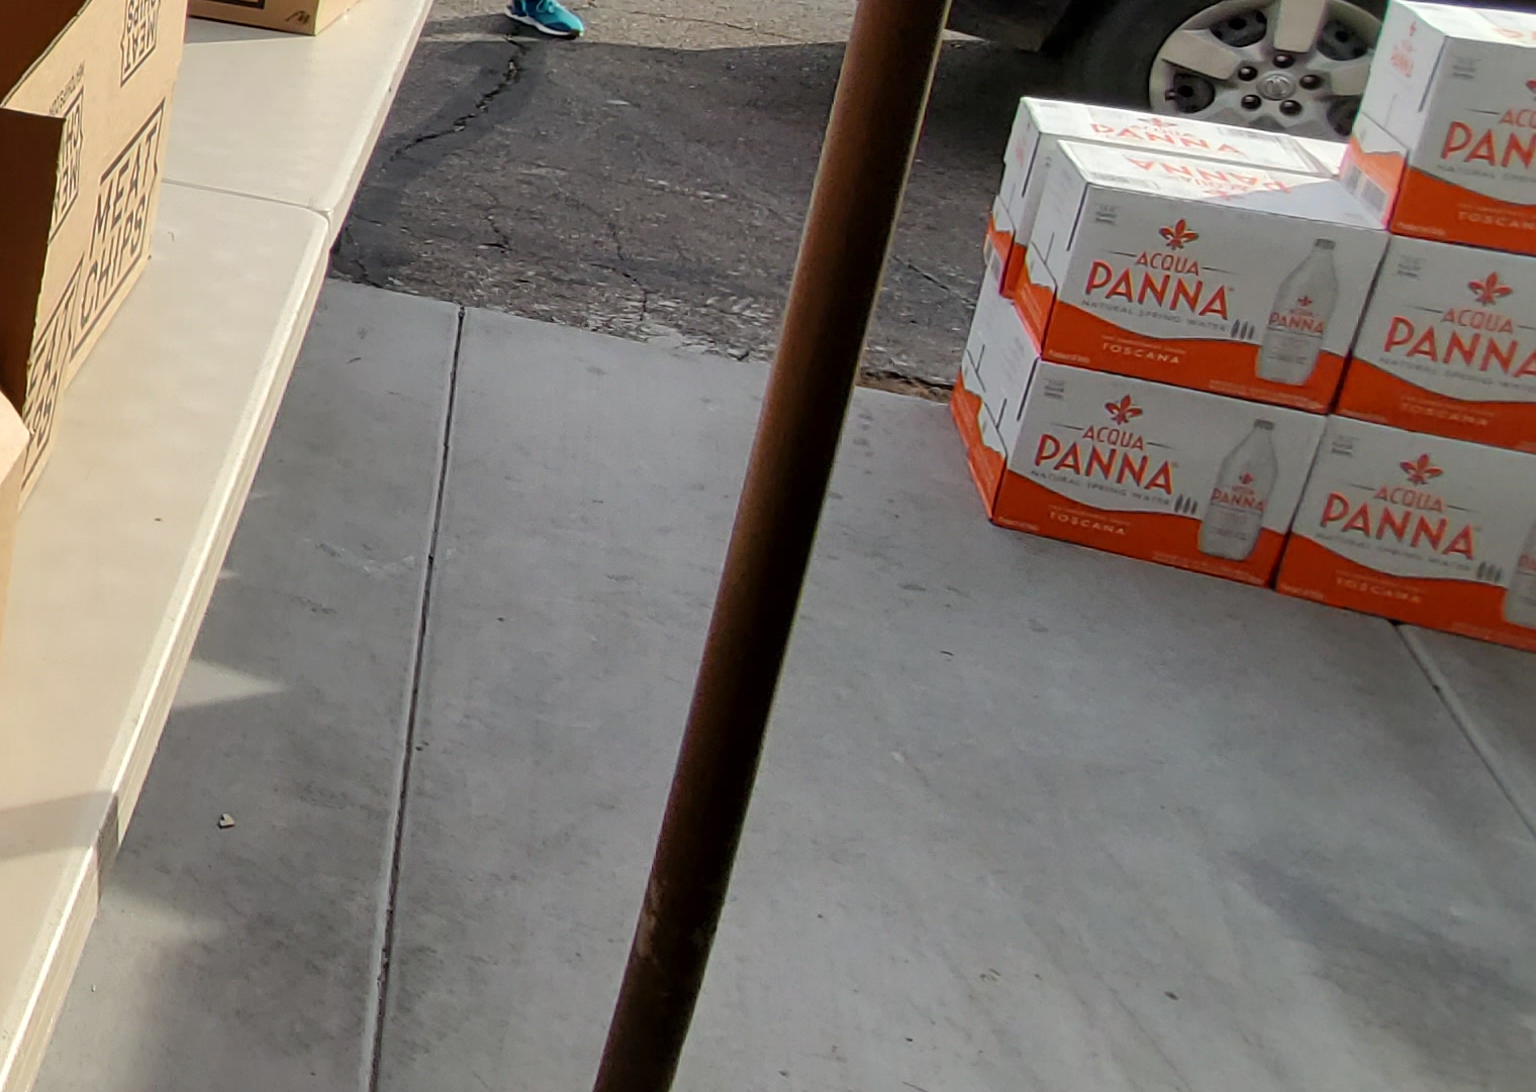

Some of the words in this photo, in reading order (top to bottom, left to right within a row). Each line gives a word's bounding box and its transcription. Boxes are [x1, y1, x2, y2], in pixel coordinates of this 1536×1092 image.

[122, 10, 156, 75] MEAT
[1090, 122, 1245, 156] PANNA
[1441, 120, 1536, 170] PAN
[1124, 154, 1291, 194] PANNA
[89, 126, 158, 261] MEAT
[80, 194, 147, 331] CHIPS
[1135, 252, 1200, 277] ACQUA
[1085, 260, 1229, 321] PANNA
[1268, 312, 1324, 335] PANNA
[1440, 308, 1514, 335] ACQUA
[1102, 342, 1180, 364] TOSCANA
[1383, 315, 1536, 378] PANNA
[1082, 425, 1145, 451] ACQUA
[1034, 433, 1174, 496] PANNA
[1210, 487, 1267, 510] PANNA
[1374, 485, 1444, 512] ACQUA
[1049, 511, 1126, 536] TOSCANA
[1319, 491, 1475, 560] PANNA
